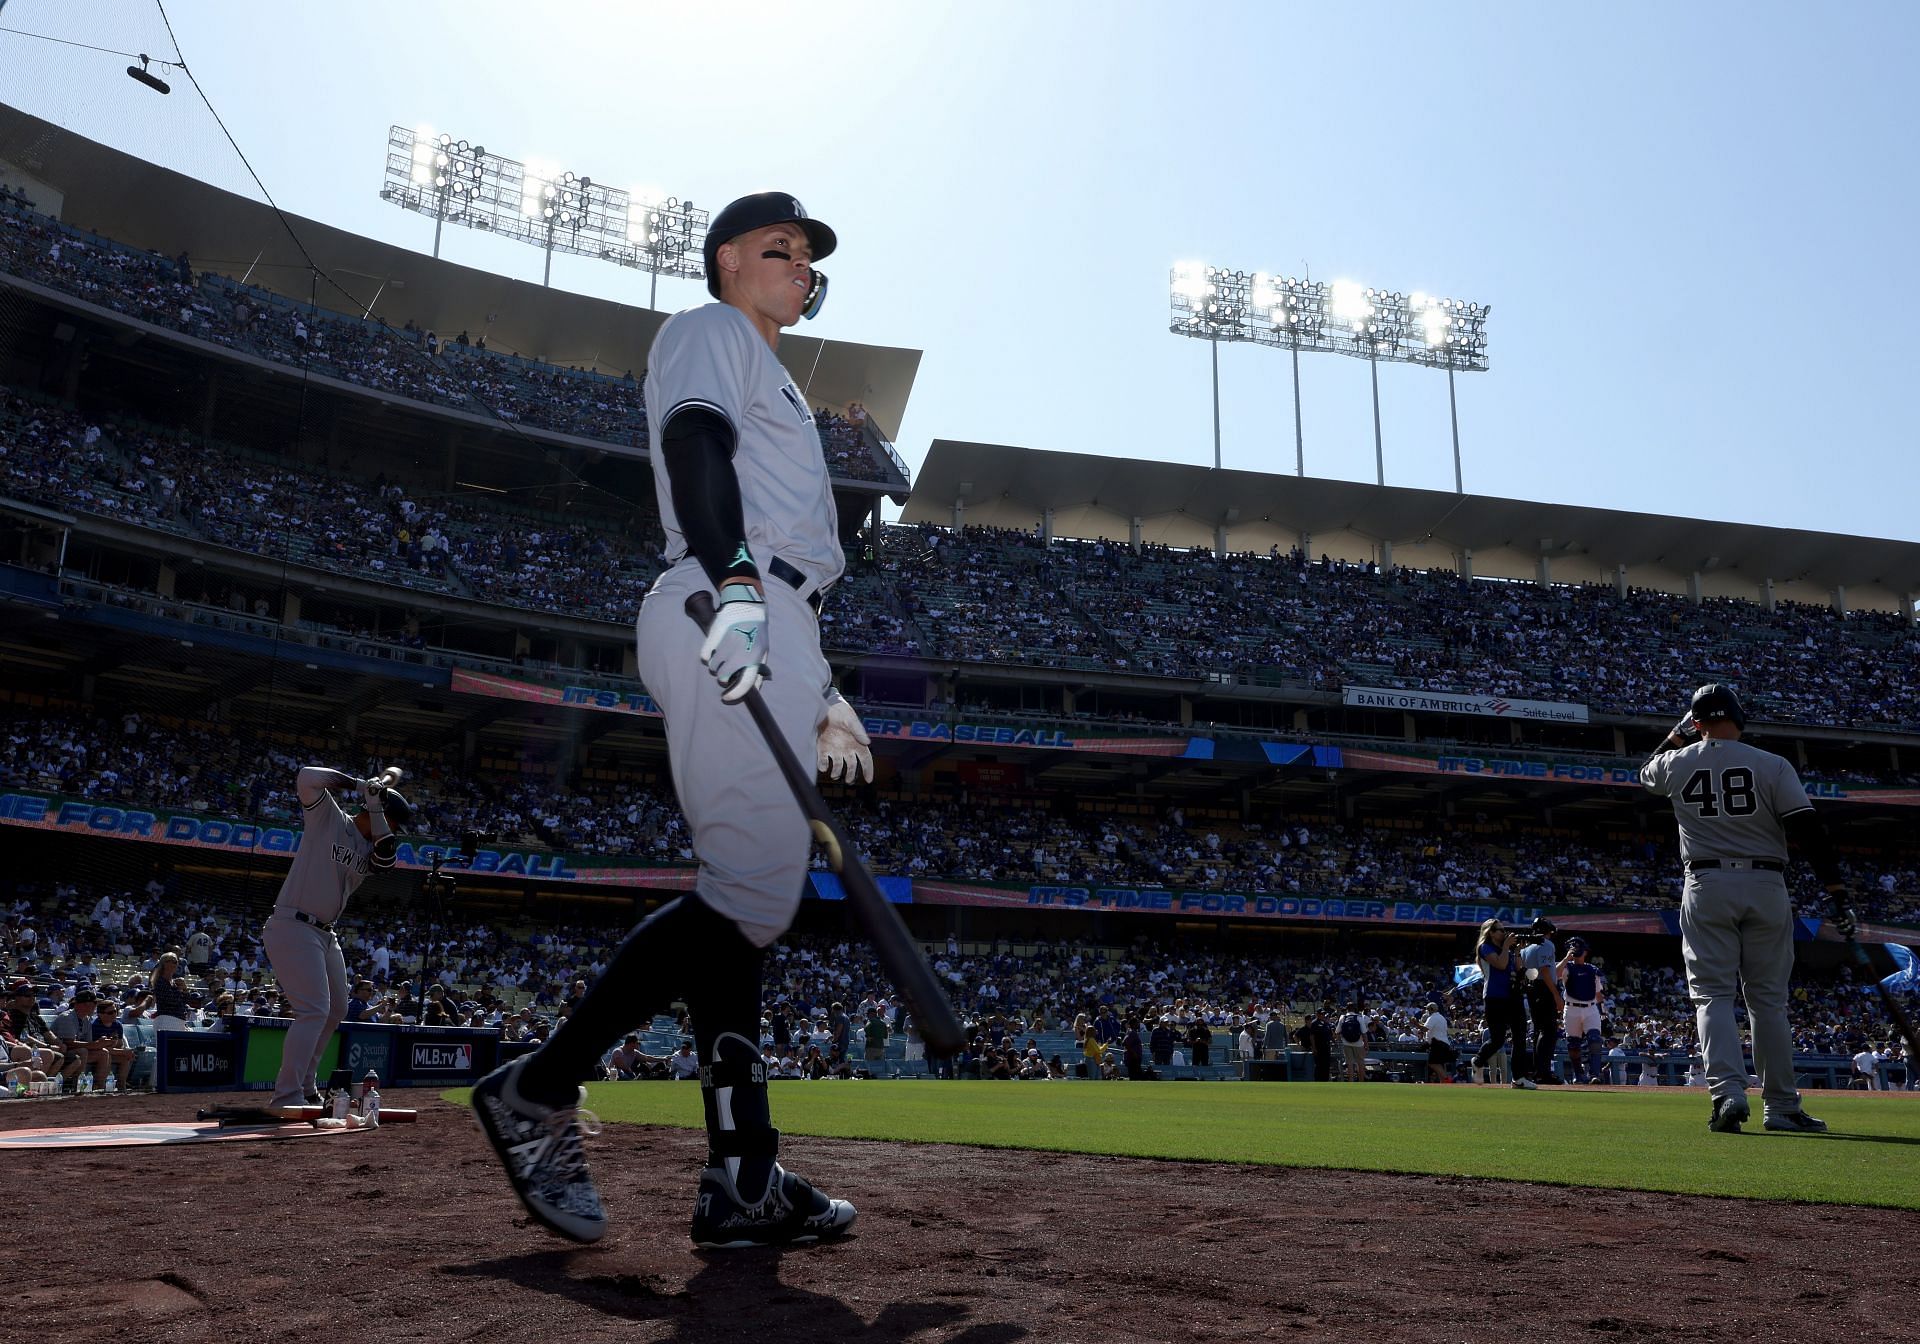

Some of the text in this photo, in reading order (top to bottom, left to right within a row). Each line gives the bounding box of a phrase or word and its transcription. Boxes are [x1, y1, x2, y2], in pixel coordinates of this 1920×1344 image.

[563, 686, 657, 713] IT'S TI
[1358, 694, 1575, 720] BANK OF AMERICA Suite Level
[863, 718, 1073, 747] ER BASEBALL
[1438, 756, 1485, 773] IT'S
[1489, 760, 1548, 777] TIME
[1554, 764, 1605, 781] FOR
[1680, 767, 1758, 818] 48
[1802, 782, 1847, 798] ALL
[57, 802, 156, 835] FOR
[165, 816, 303, 852] DODG
[396, 842, 576, 878] ASEBALL
[331, 843, 355, 867] NEW
[1028, 886, 1090, 906] IT'S
[1096, 888, 1174, 909] TIME
[1180, 892, 1248, 913] FOR
[1255, 895, 1386, 919] DODGER
[197, 938, 208, 946] 42
[191, 1054, 214, 1072] MLB
[752, 1062, 764, 1083] 99
